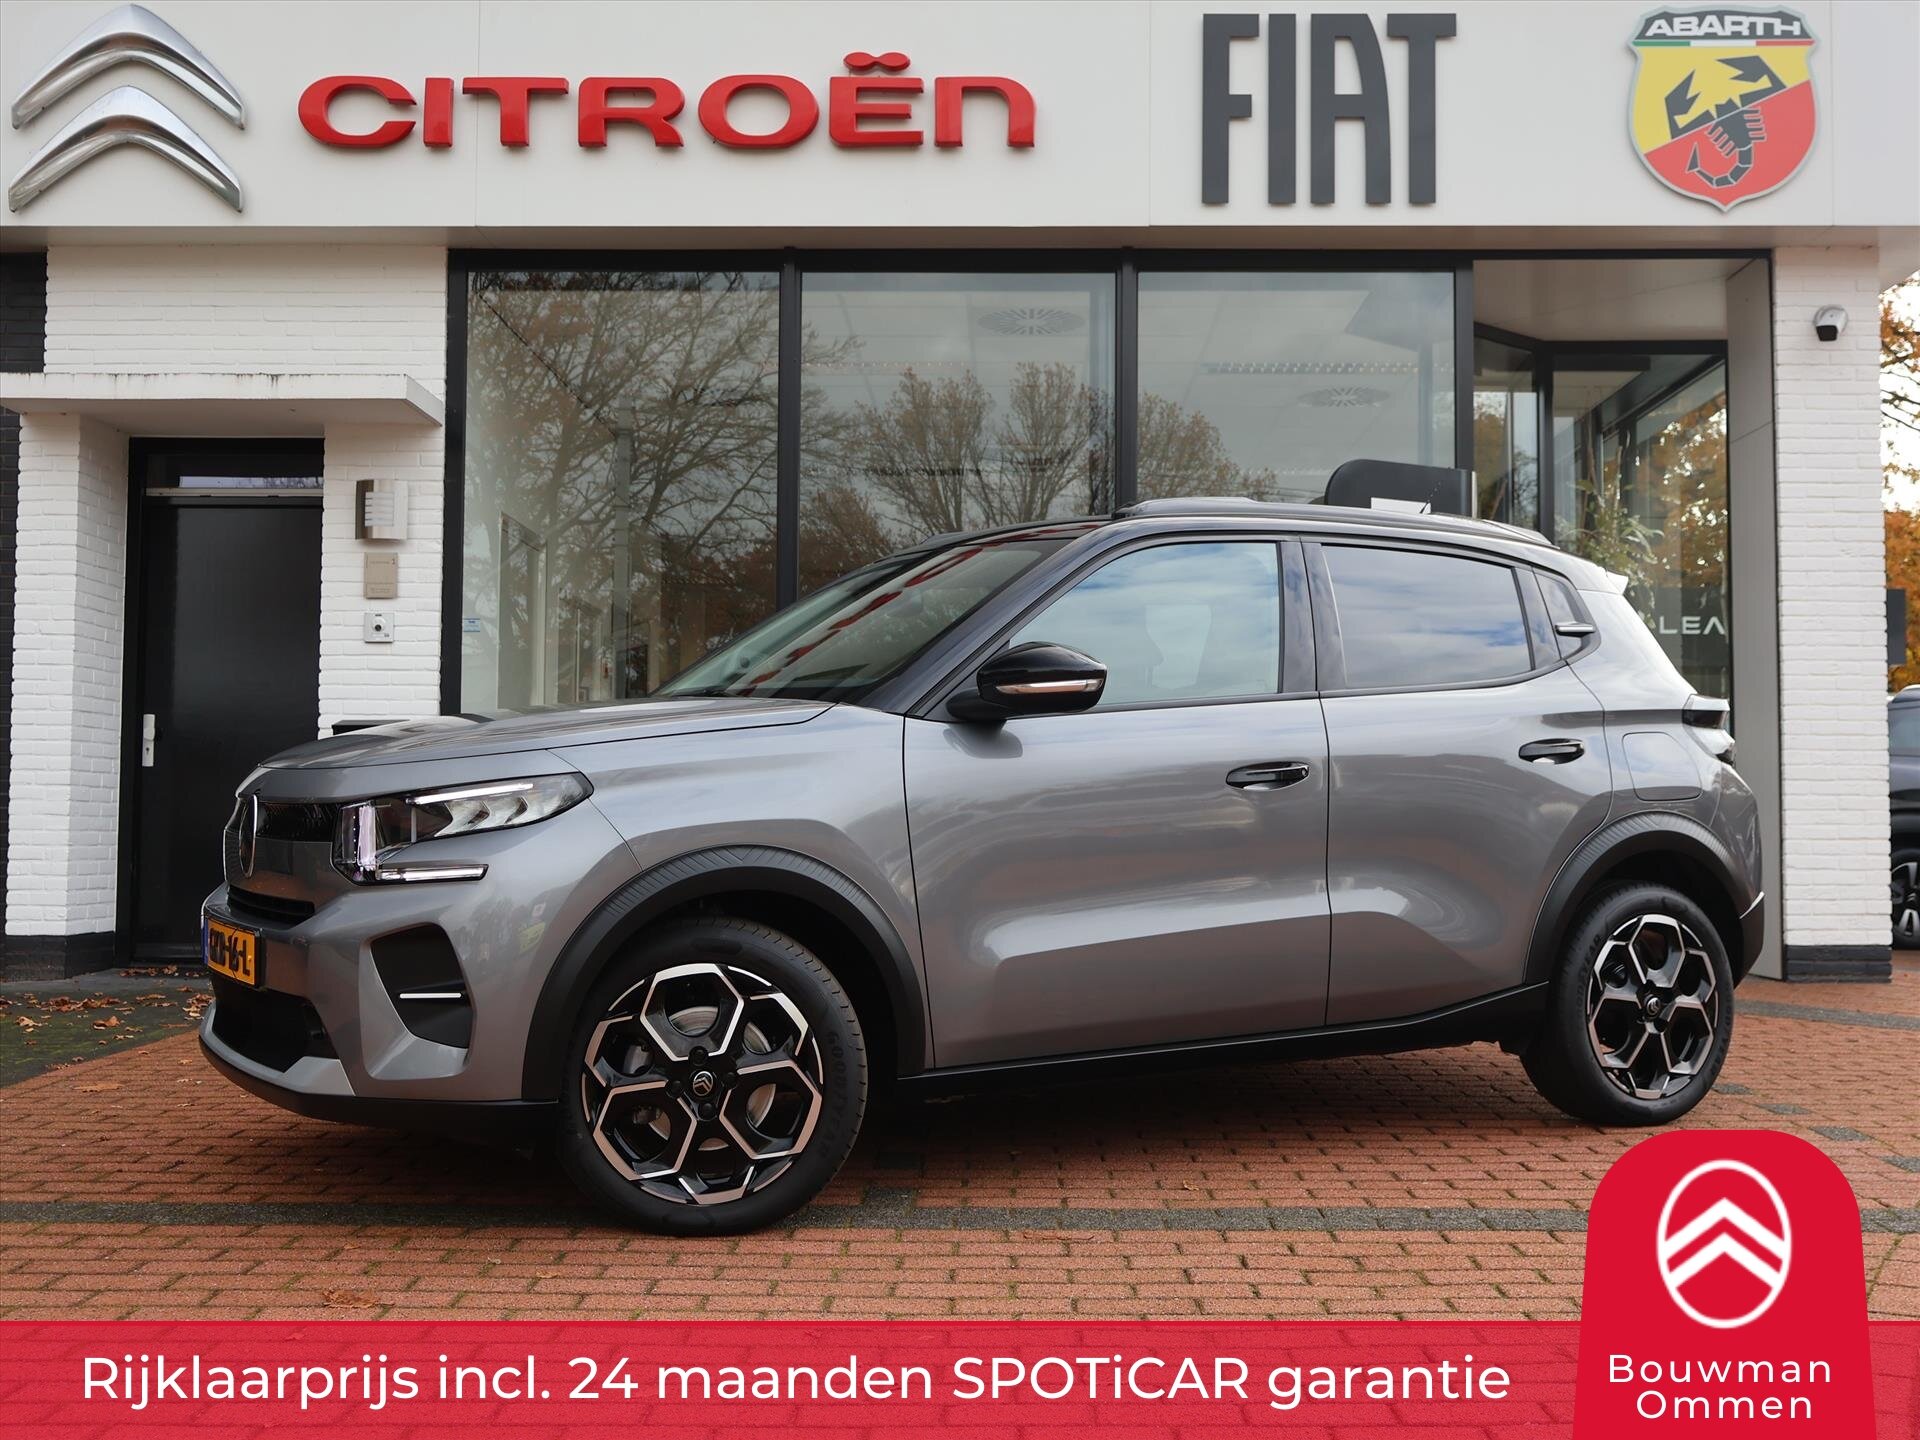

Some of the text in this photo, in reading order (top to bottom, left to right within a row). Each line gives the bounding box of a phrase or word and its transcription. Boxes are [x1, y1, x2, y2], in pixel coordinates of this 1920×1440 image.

[1645, 15, 1800, 36] ABARTH
[299, 52, 1036, 148] CITROËN
[1202, 14, 1457, 205] FIAT
